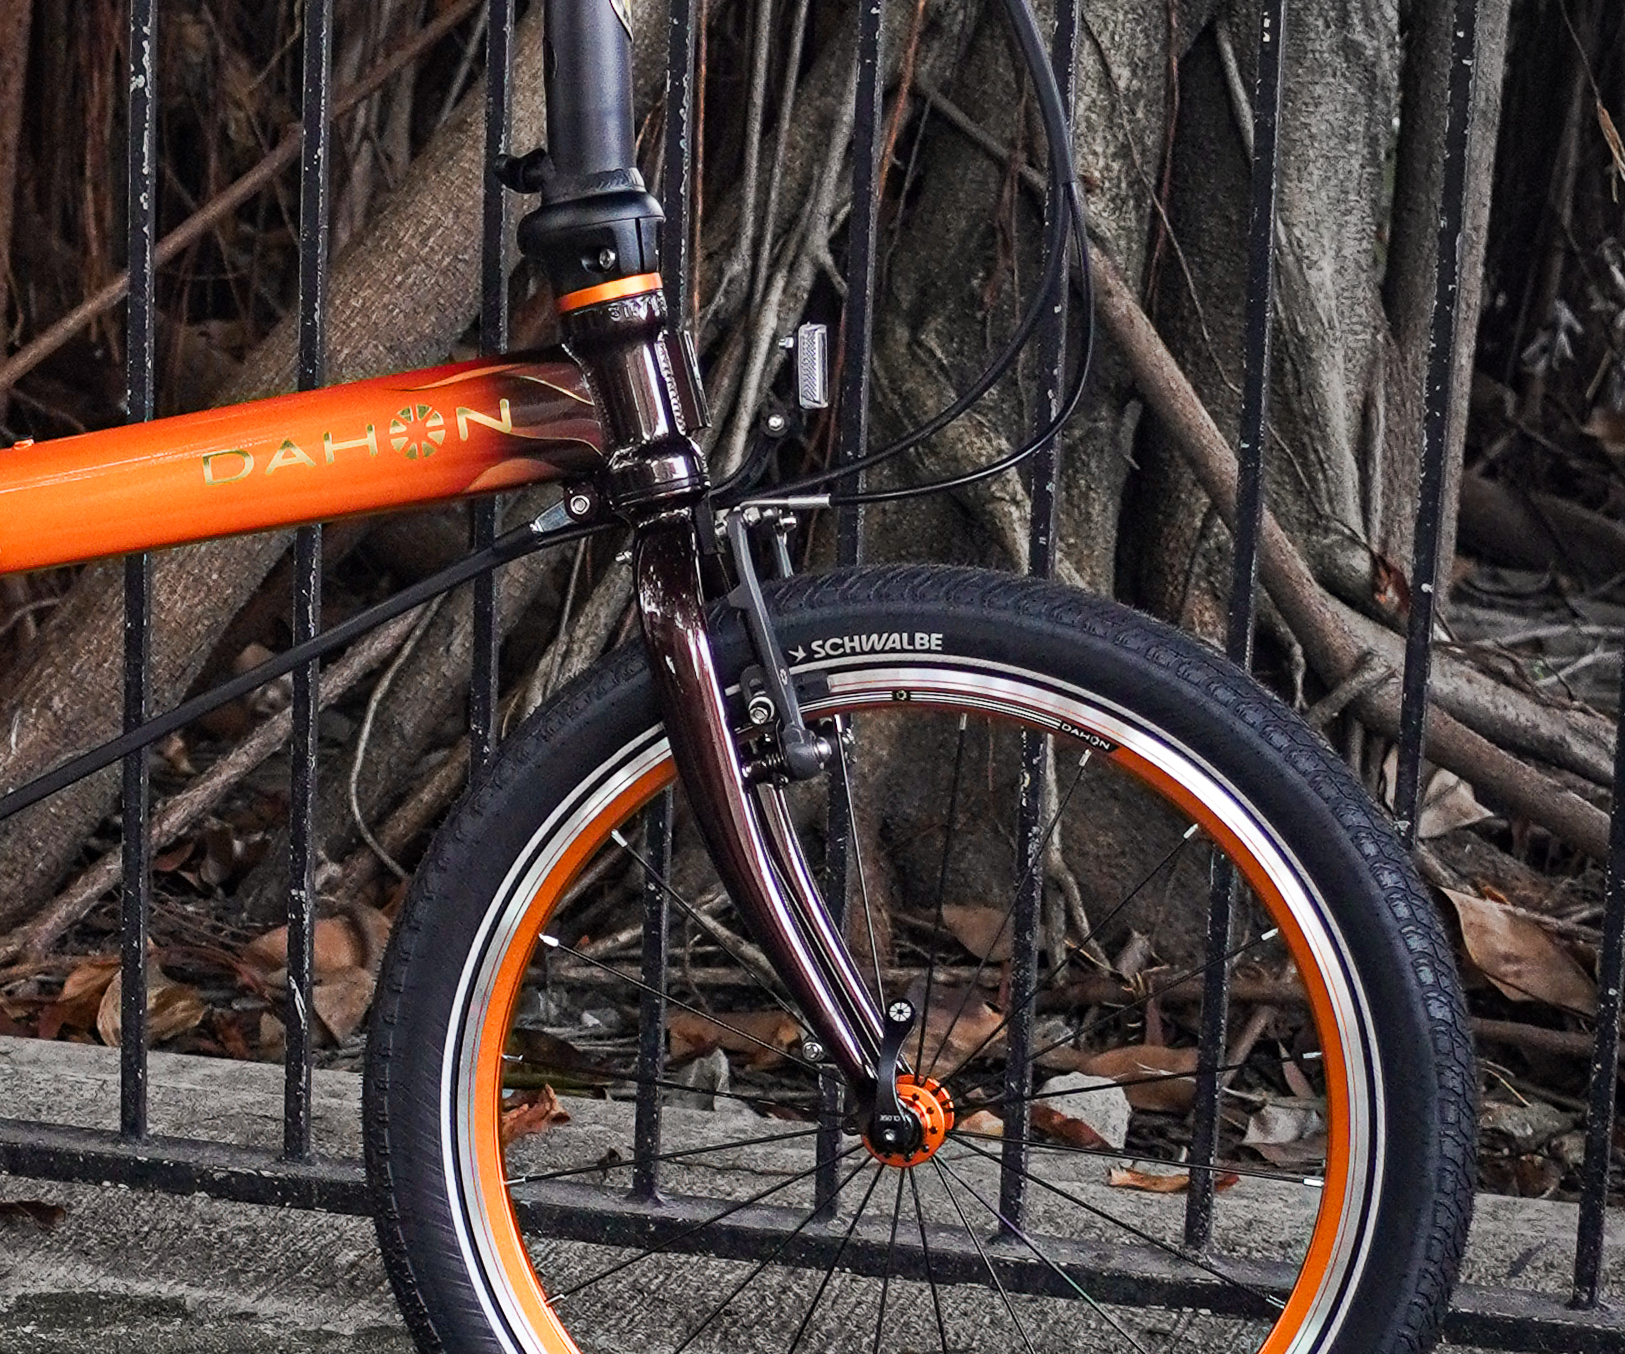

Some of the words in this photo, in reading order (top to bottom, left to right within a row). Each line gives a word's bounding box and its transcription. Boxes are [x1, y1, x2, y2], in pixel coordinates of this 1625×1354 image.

[201, 397, 512, 486] DAHON
[811, 632, 943, 659] SCHWALBE
[1061, 723, 1110, 750] DAHON
